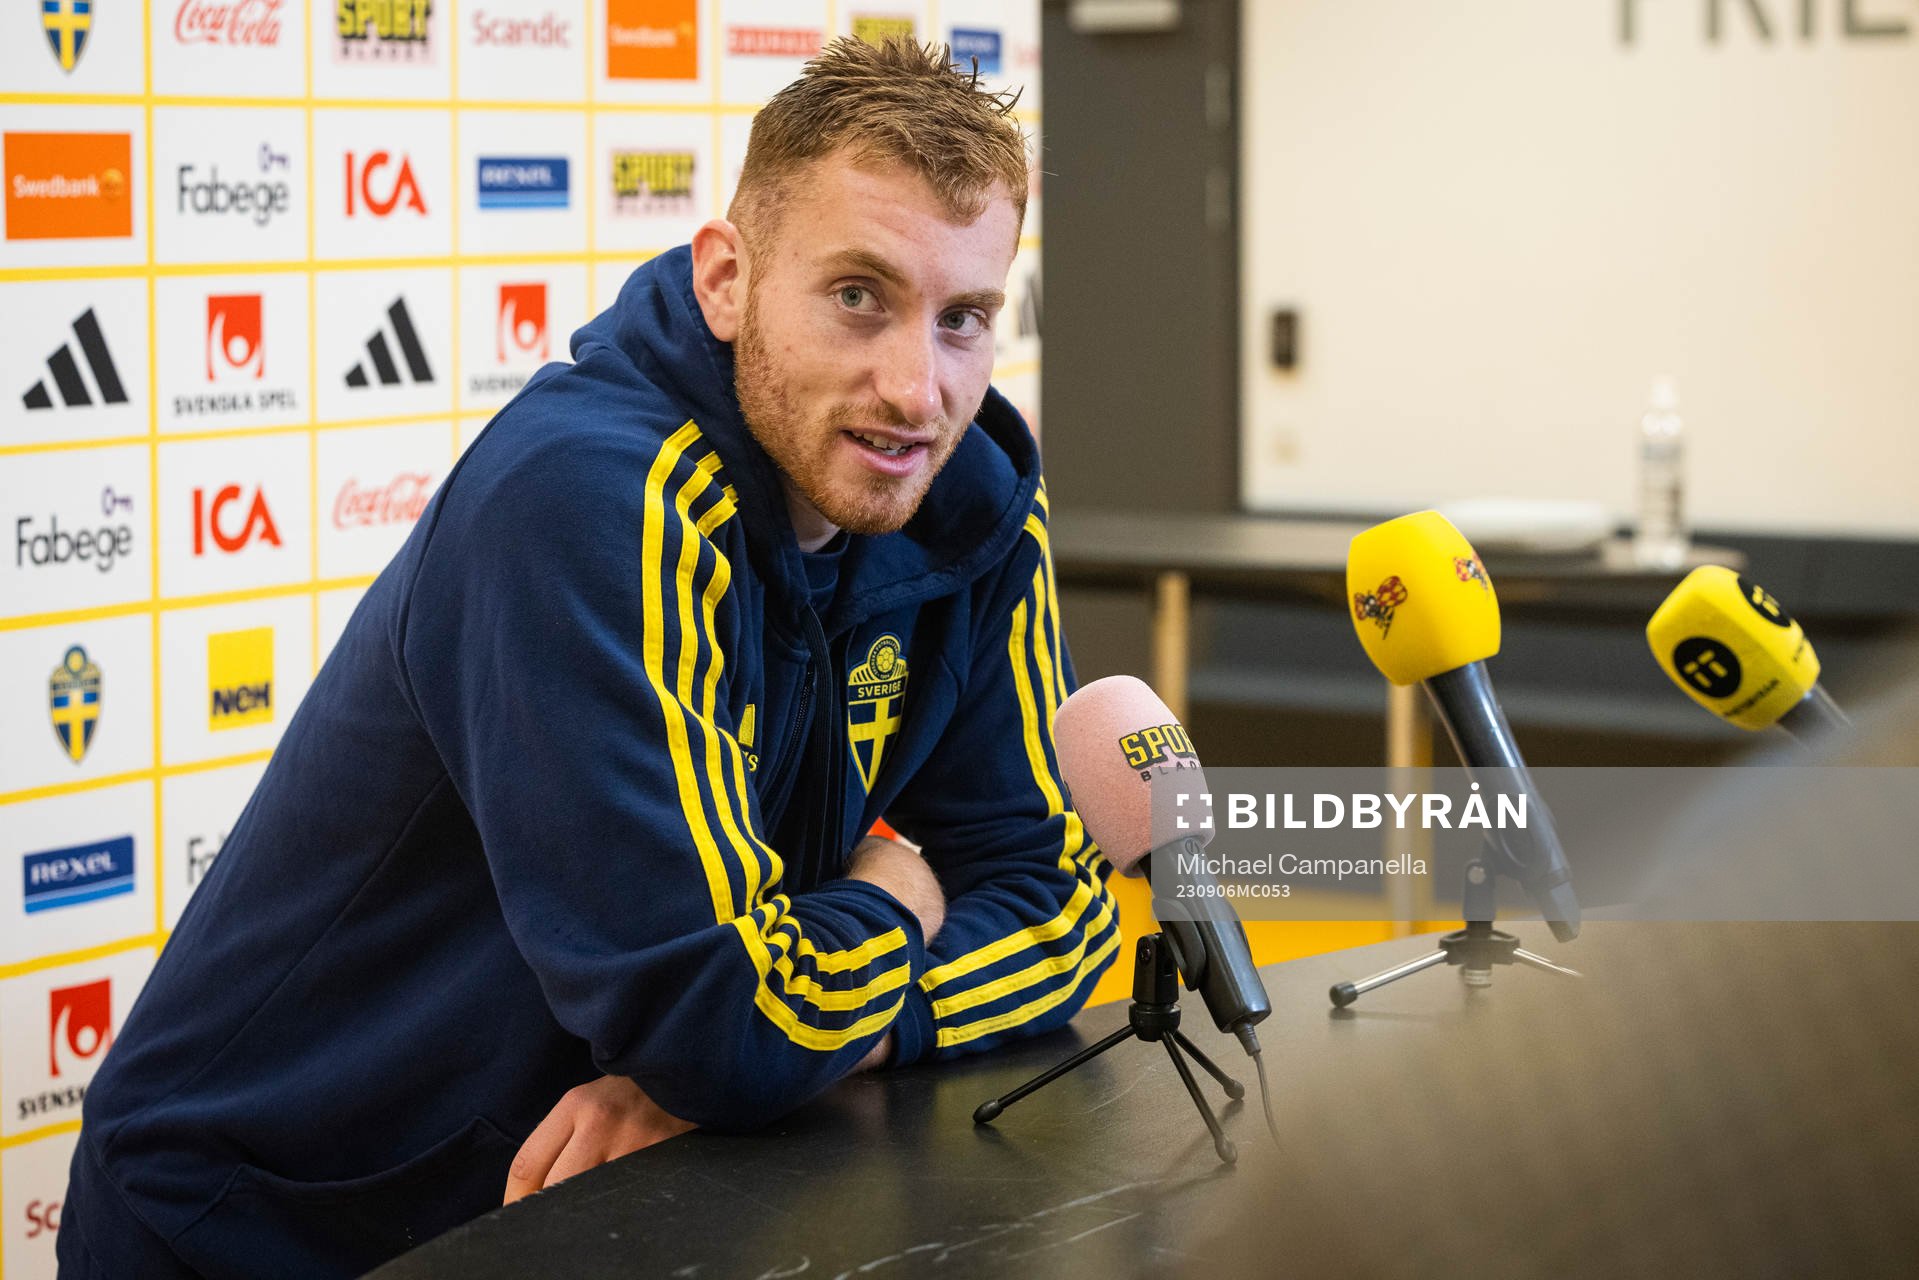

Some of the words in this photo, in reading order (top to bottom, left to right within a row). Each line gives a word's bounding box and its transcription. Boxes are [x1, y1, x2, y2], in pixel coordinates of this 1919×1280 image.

[472, 10, 570, 47] Scandic
[13, 175, 98, 198] Swedbank
[177, 163, 289, 227] Fabege
[345, 151, 428, 217] ICA
[173, 391, 255, 417] SVENSKA
[193, 482, 283, 556] ICA
[16, 514, 133, 573] Fabege
[857, 680, 902, 698] SVERIGE
